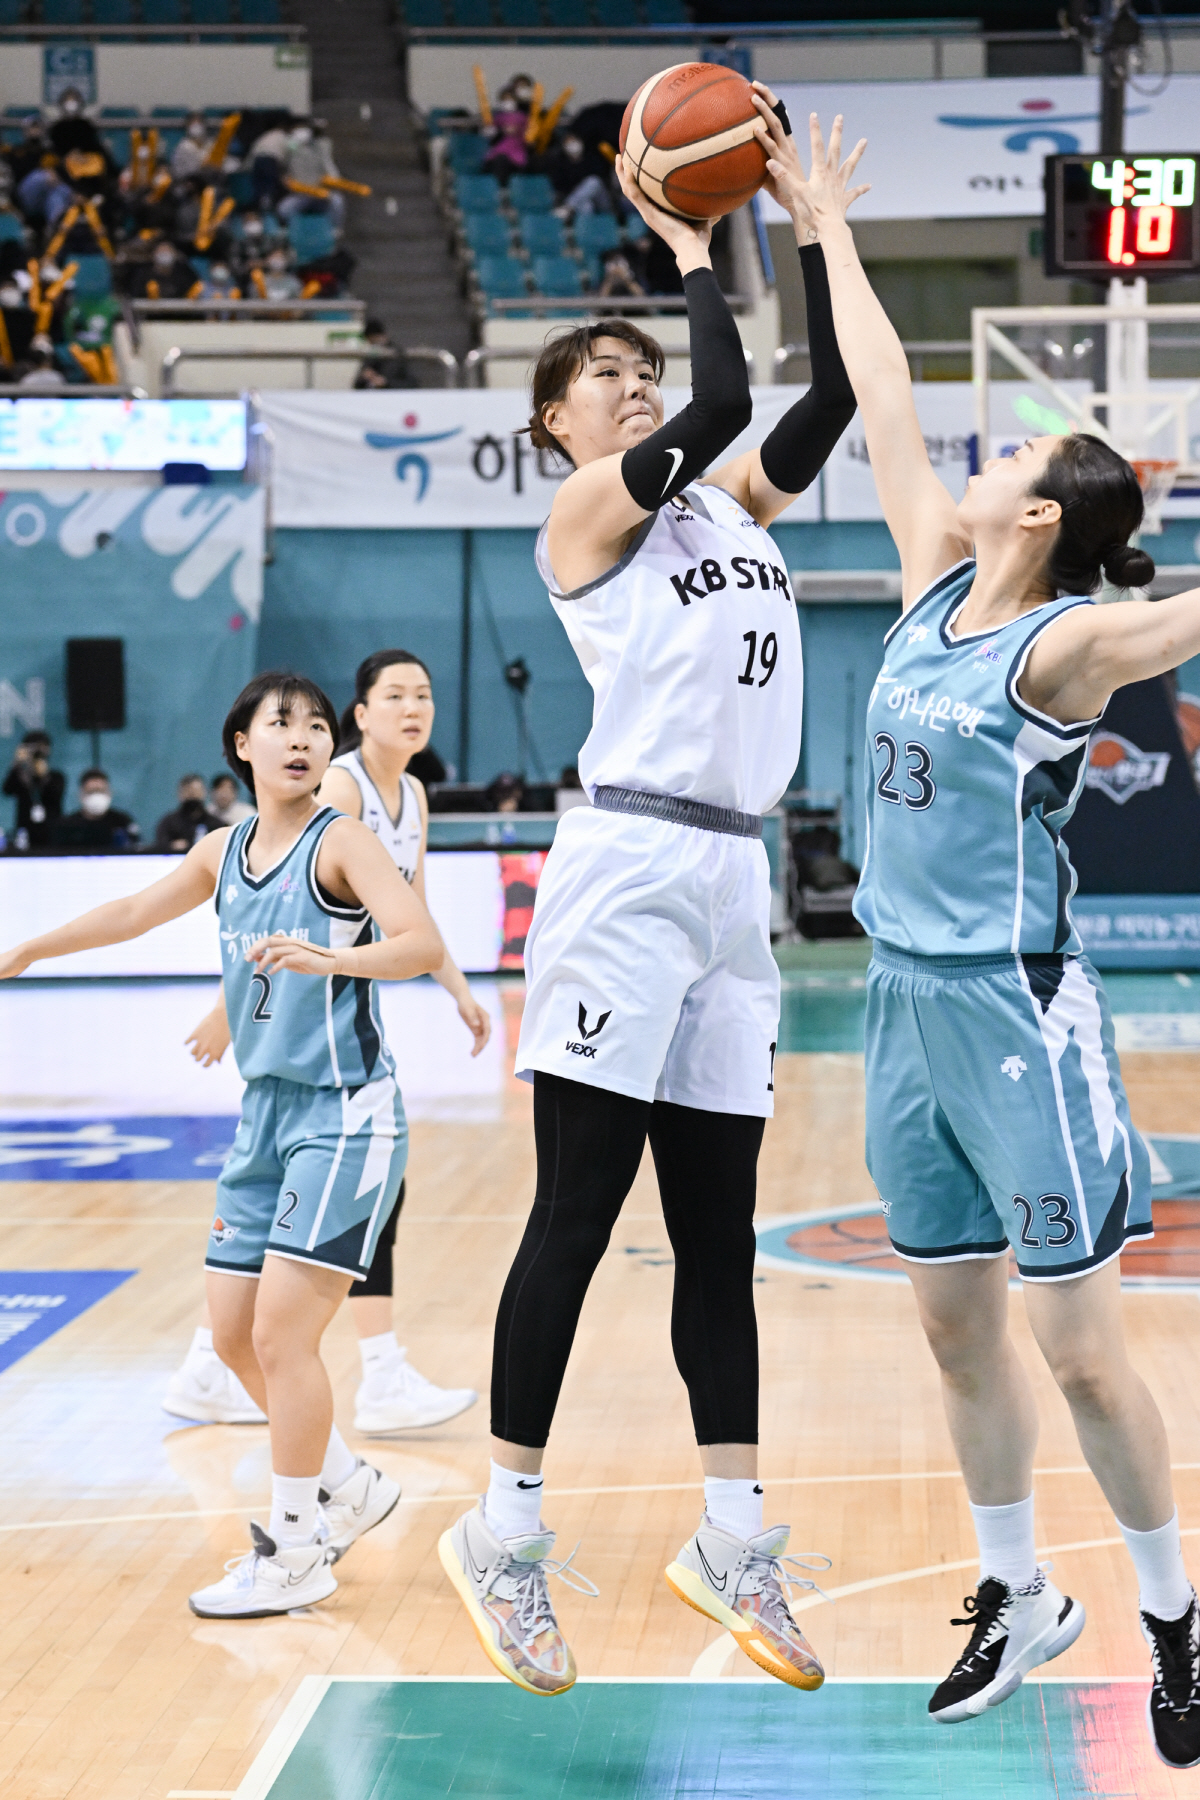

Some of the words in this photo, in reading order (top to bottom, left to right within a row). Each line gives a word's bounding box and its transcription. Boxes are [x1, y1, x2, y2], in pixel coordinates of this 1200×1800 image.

[1092, 159, 1196, 207] 4:30
[1108, 205, 1173, 265] 1.0
[669, 558, 728, 607] KB
[737, 630, 778, 688] 19
[887, 685, 986, 738] 하나은행
[874, 731, 937, 812] 23
[250, 971, 274, 1023] 2
[565, 1040, 598, 1060] VEXX
[274, 1188, 301, 1233] 2
[1011, 1192, 1079, 1249] 23
